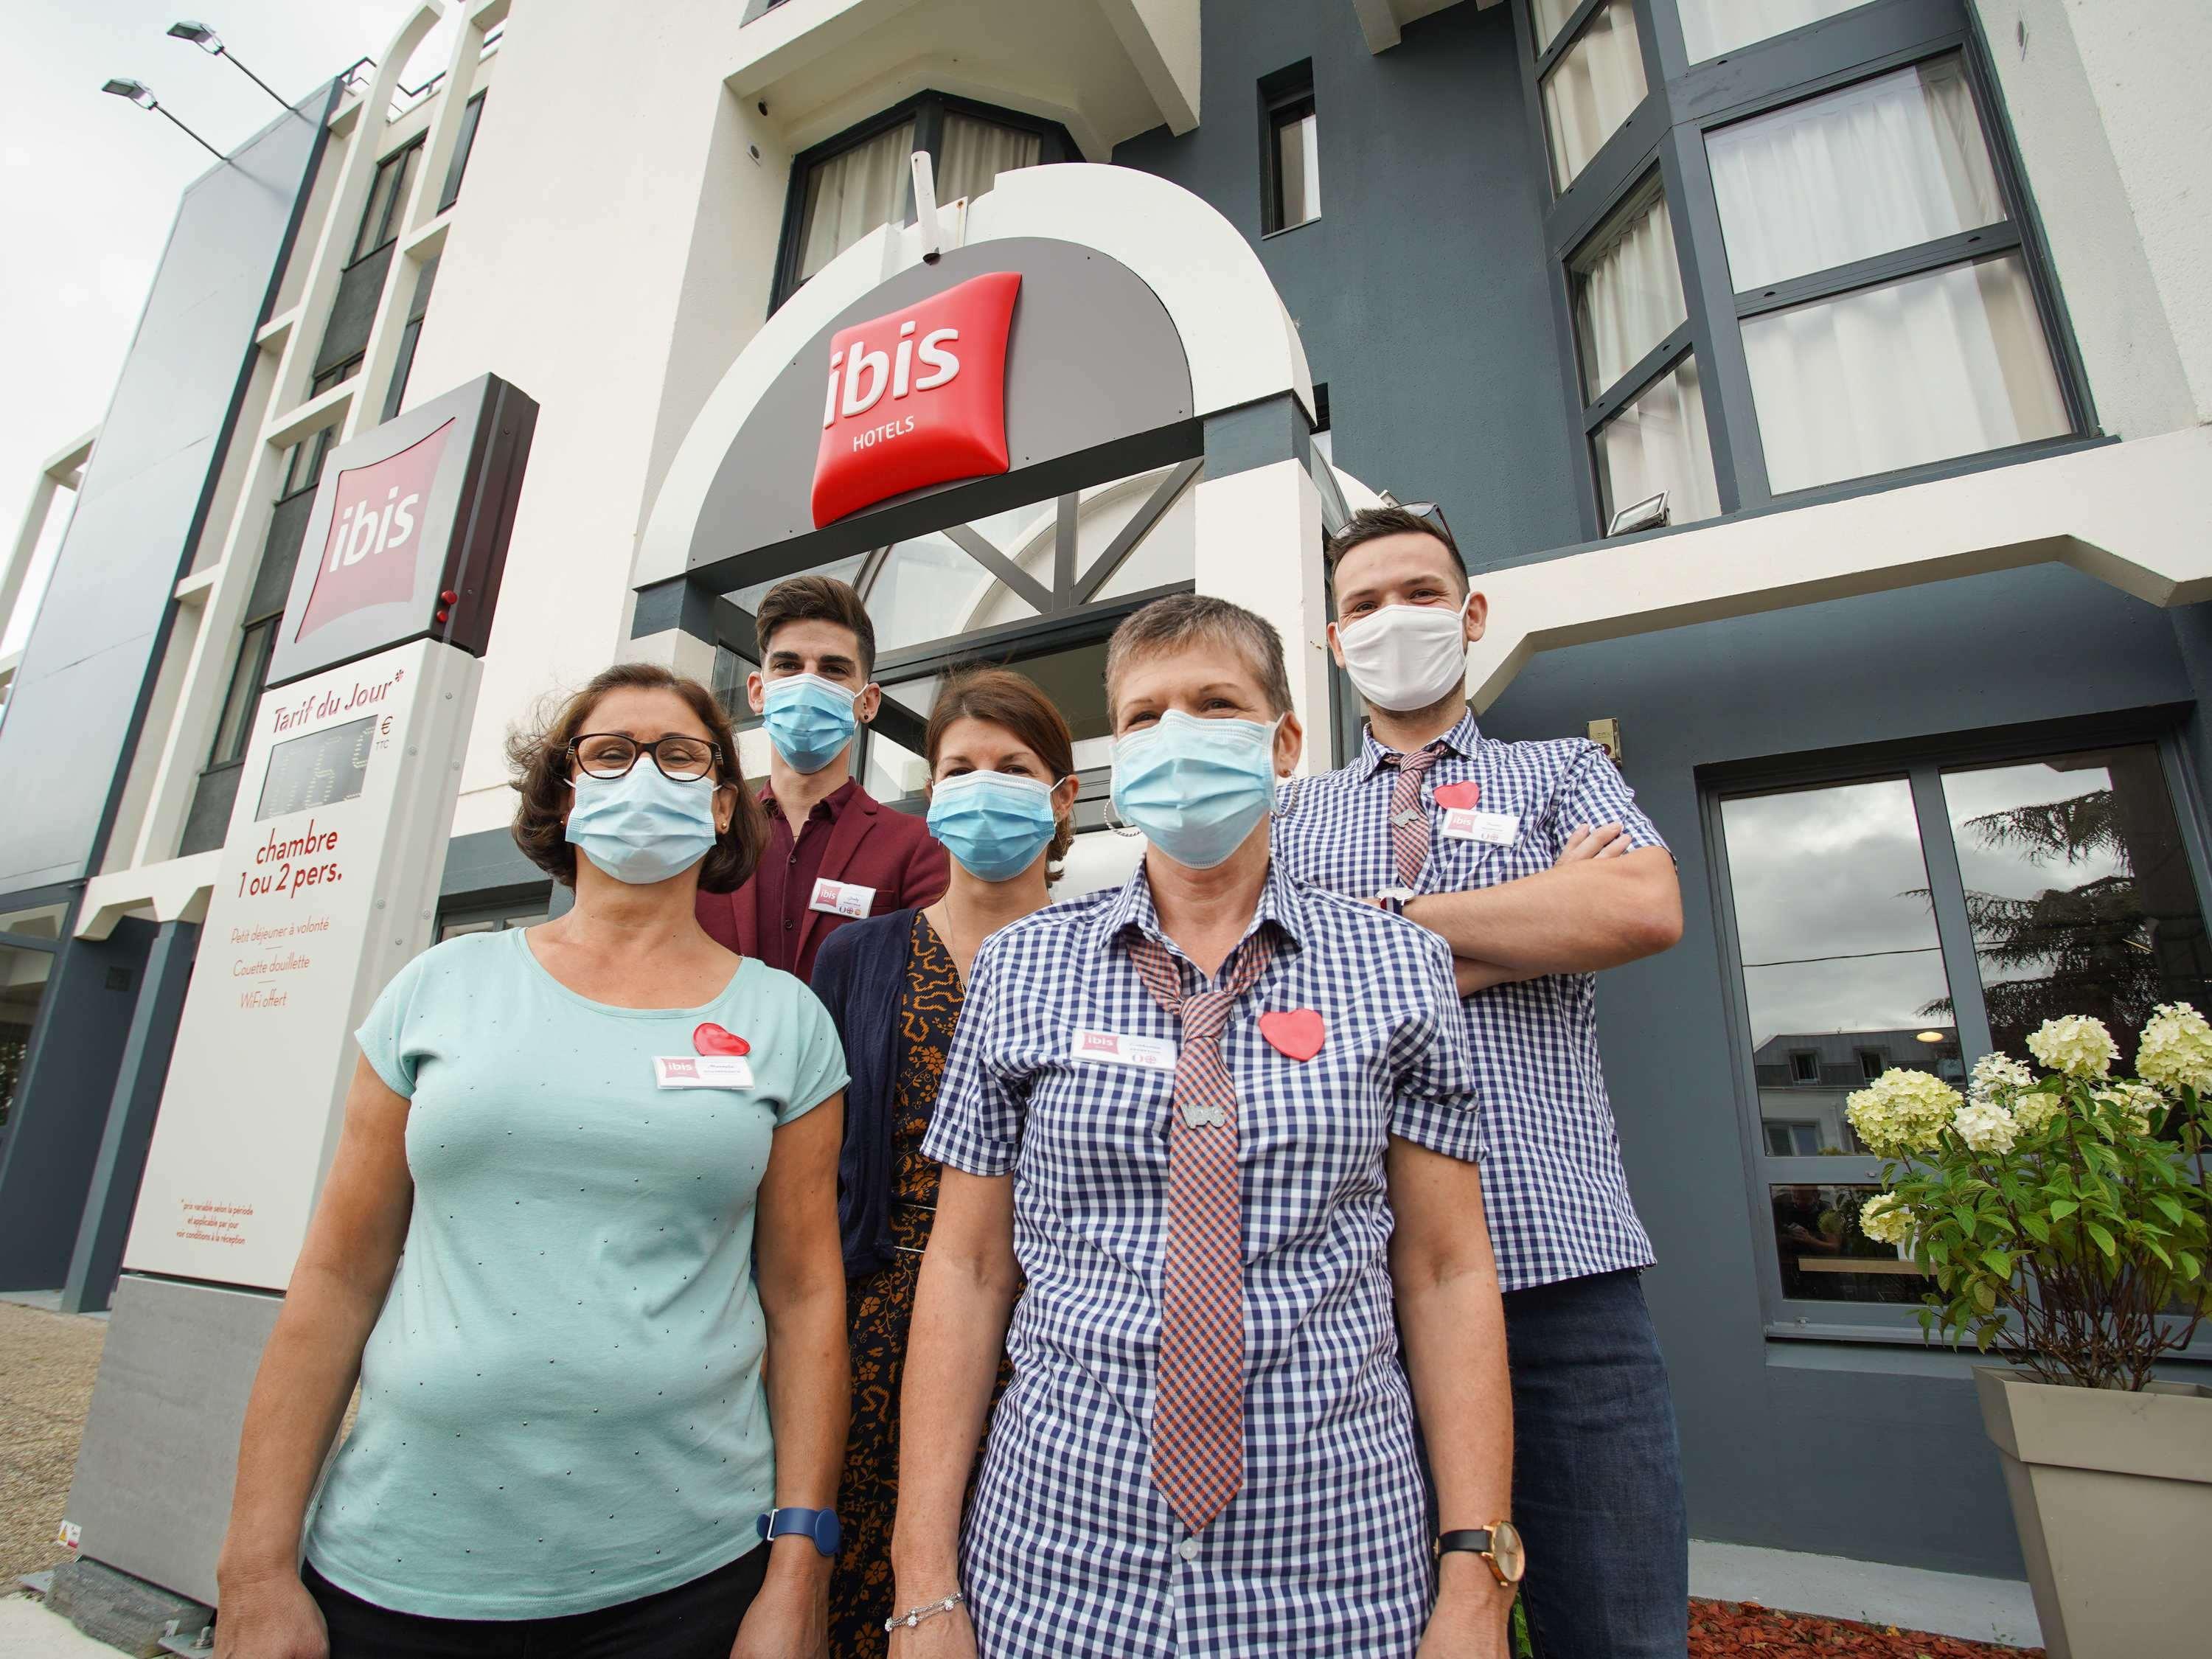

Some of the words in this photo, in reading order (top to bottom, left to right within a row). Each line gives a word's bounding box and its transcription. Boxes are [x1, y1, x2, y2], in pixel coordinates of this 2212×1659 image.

[823, 320, 960, 428] ibis
[852, 415, 915, 452] HOTELS
[329, 486, 419, 573] ibis
[274, 695, 316, 734] Tarif
[316, 690, 341, 720] du
[256, 818, 338, 864] chambre
[275, 863, 290, 891] 2
[290, 863, 342, 899] pers.
[820, 890, 837, 900] ibis
[230, 928, 249, 945] Petit
[251, 922, 288, 945] déjeuner
[289, 922, 295, 936] à
[297, 915, 330, 933] volonté
[233, 959, 267, 977] Couette
[269, 952, 310, 973] douillette
[241, 991, 262, 1009] WiFi
[263, 988, 288, 1007] offert
[194, 1200, 213, 1211] variable
[213, 1201, 227, 1213] selon
[232, 1203, 254, 1217] période
[186, 1230, 210, 1241] conditions
